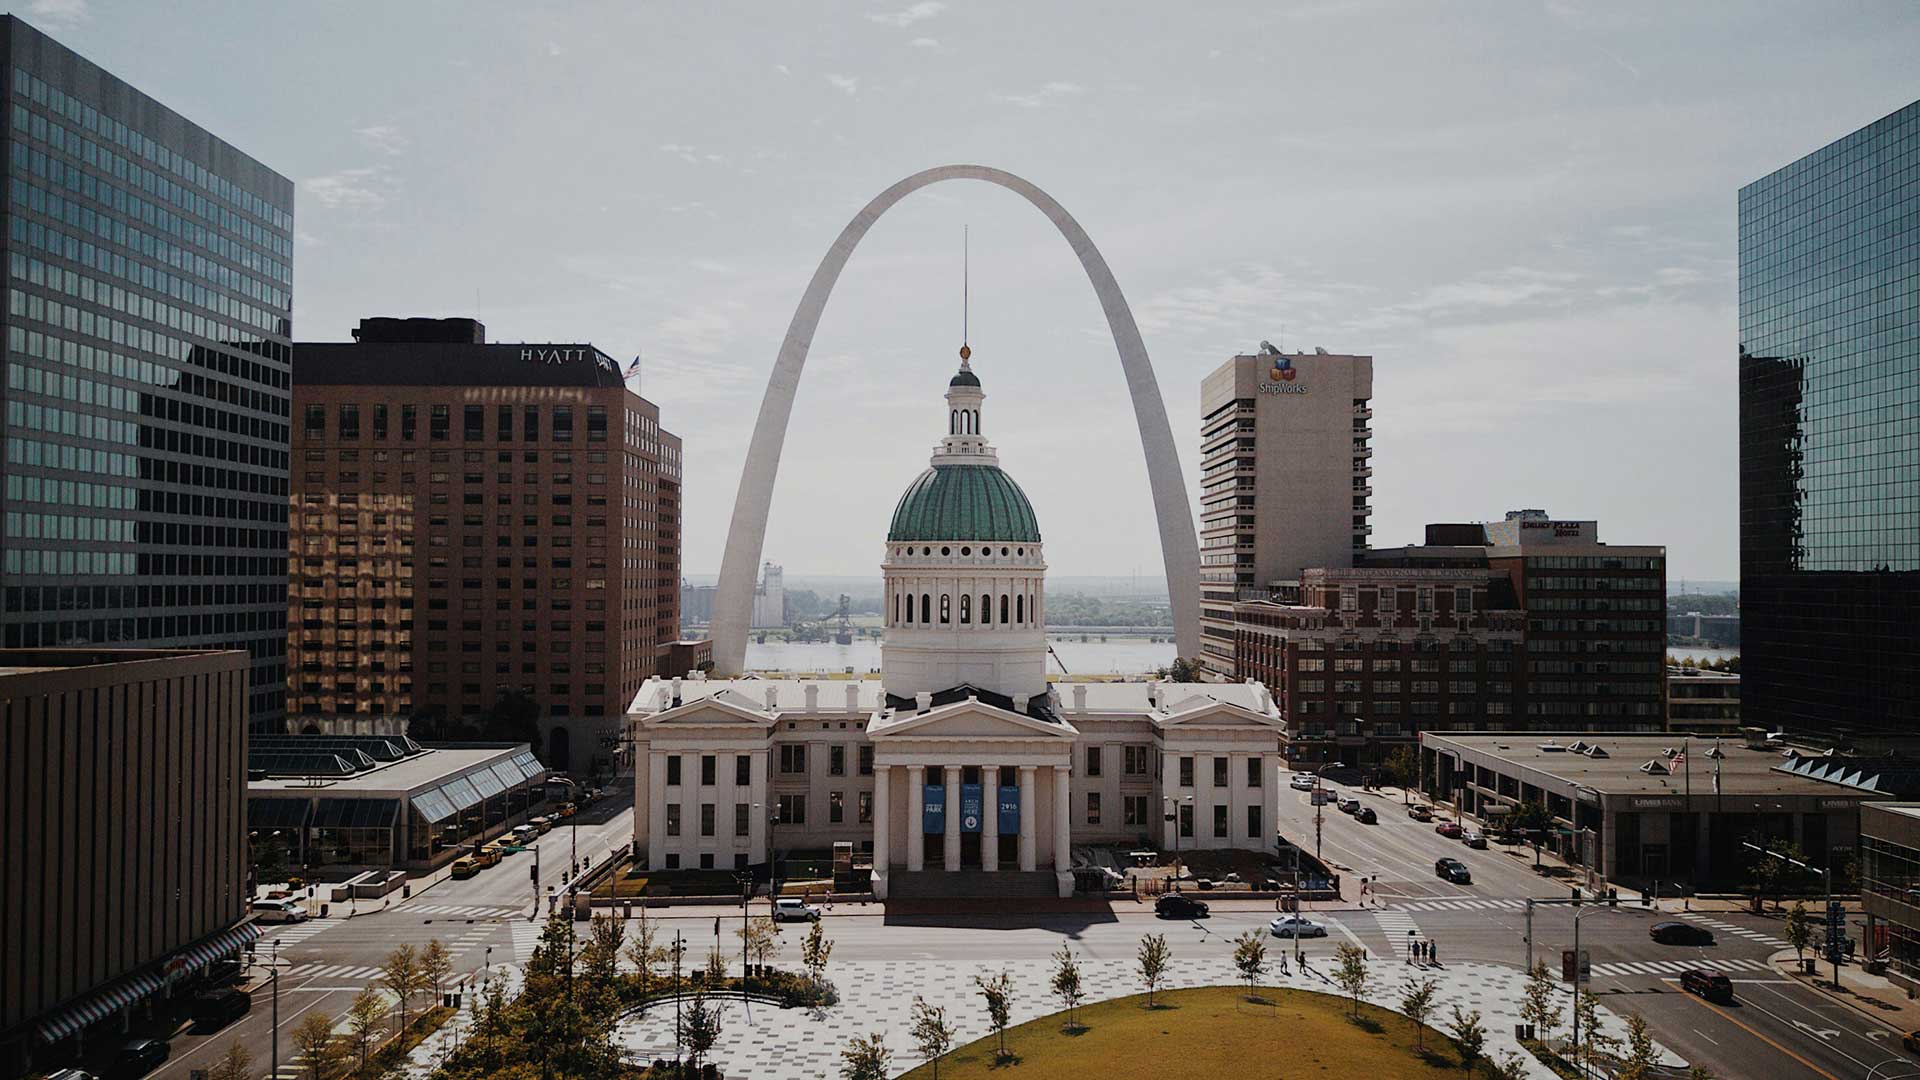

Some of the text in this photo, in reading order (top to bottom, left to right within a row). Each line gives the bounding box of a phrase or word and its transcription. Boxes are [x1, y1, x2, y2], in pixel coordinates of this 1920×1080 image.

[520, 349, 586, 364] HYATT
[1259, 382, 1307, 395] ShipWorks
[1822, 800, 1849, 808] UMB
